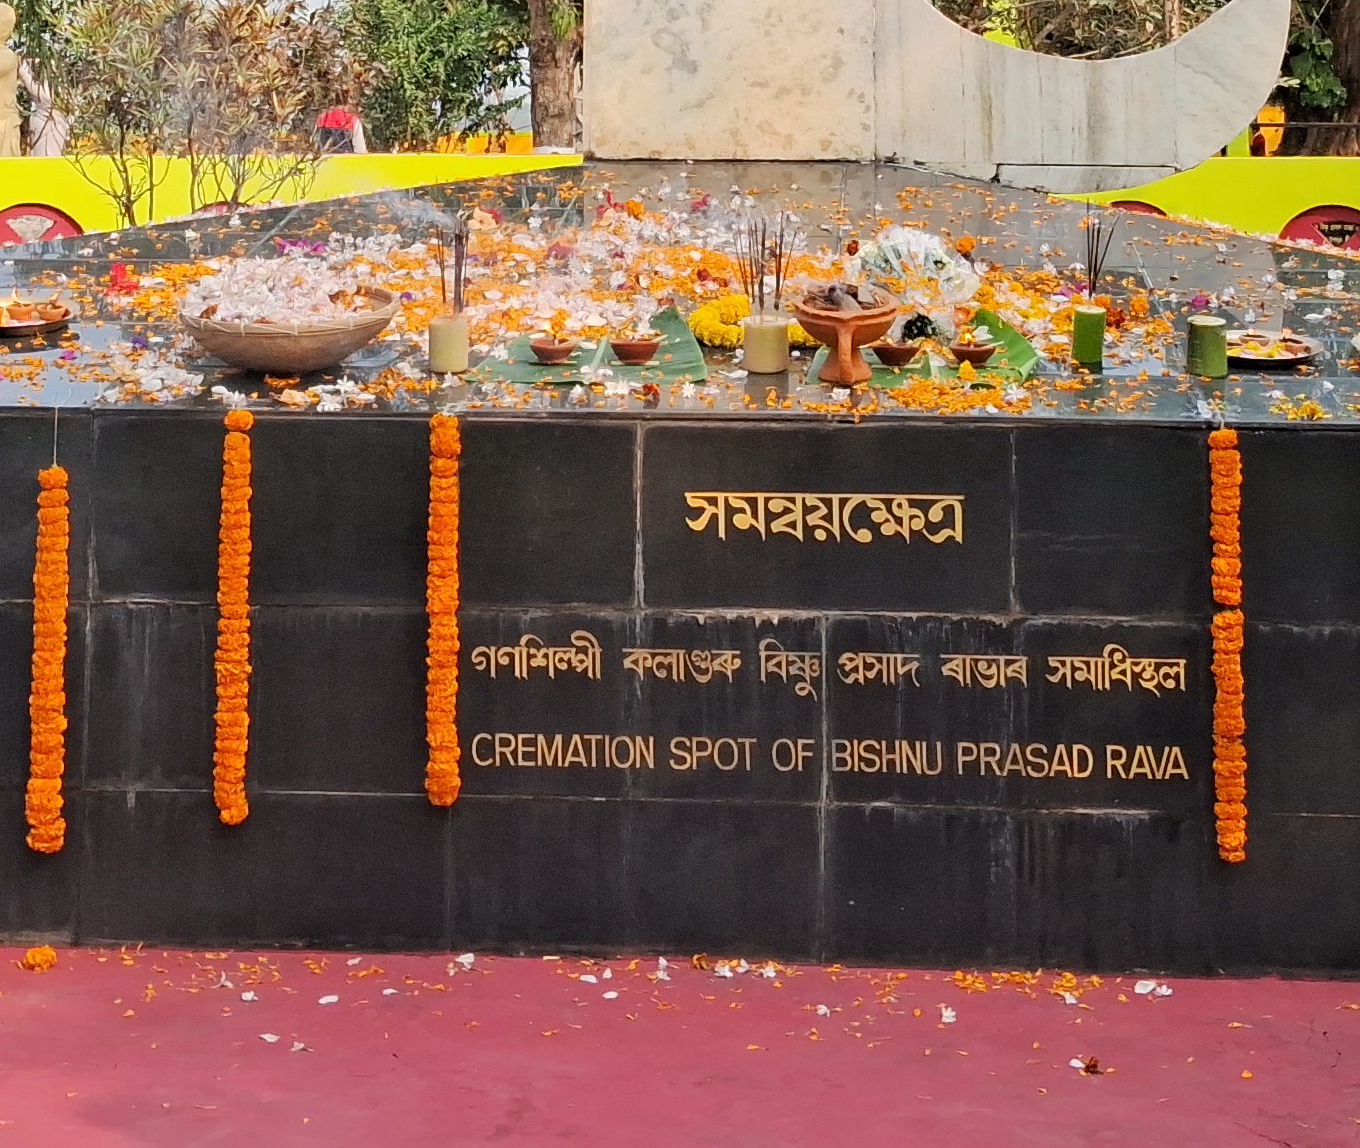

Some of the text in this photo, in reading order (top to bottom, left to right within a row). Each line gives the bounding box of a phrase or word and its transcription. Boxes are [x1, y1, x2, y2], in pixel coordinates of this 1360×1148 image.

[470, 629, 603, 681] গণশিল্পী
[1044, 643, 1187, 699] সমাধিস্থল
[471, 732, 1190, 781] CREMATION SPOT OF BISHNU PRASAD RAVA
